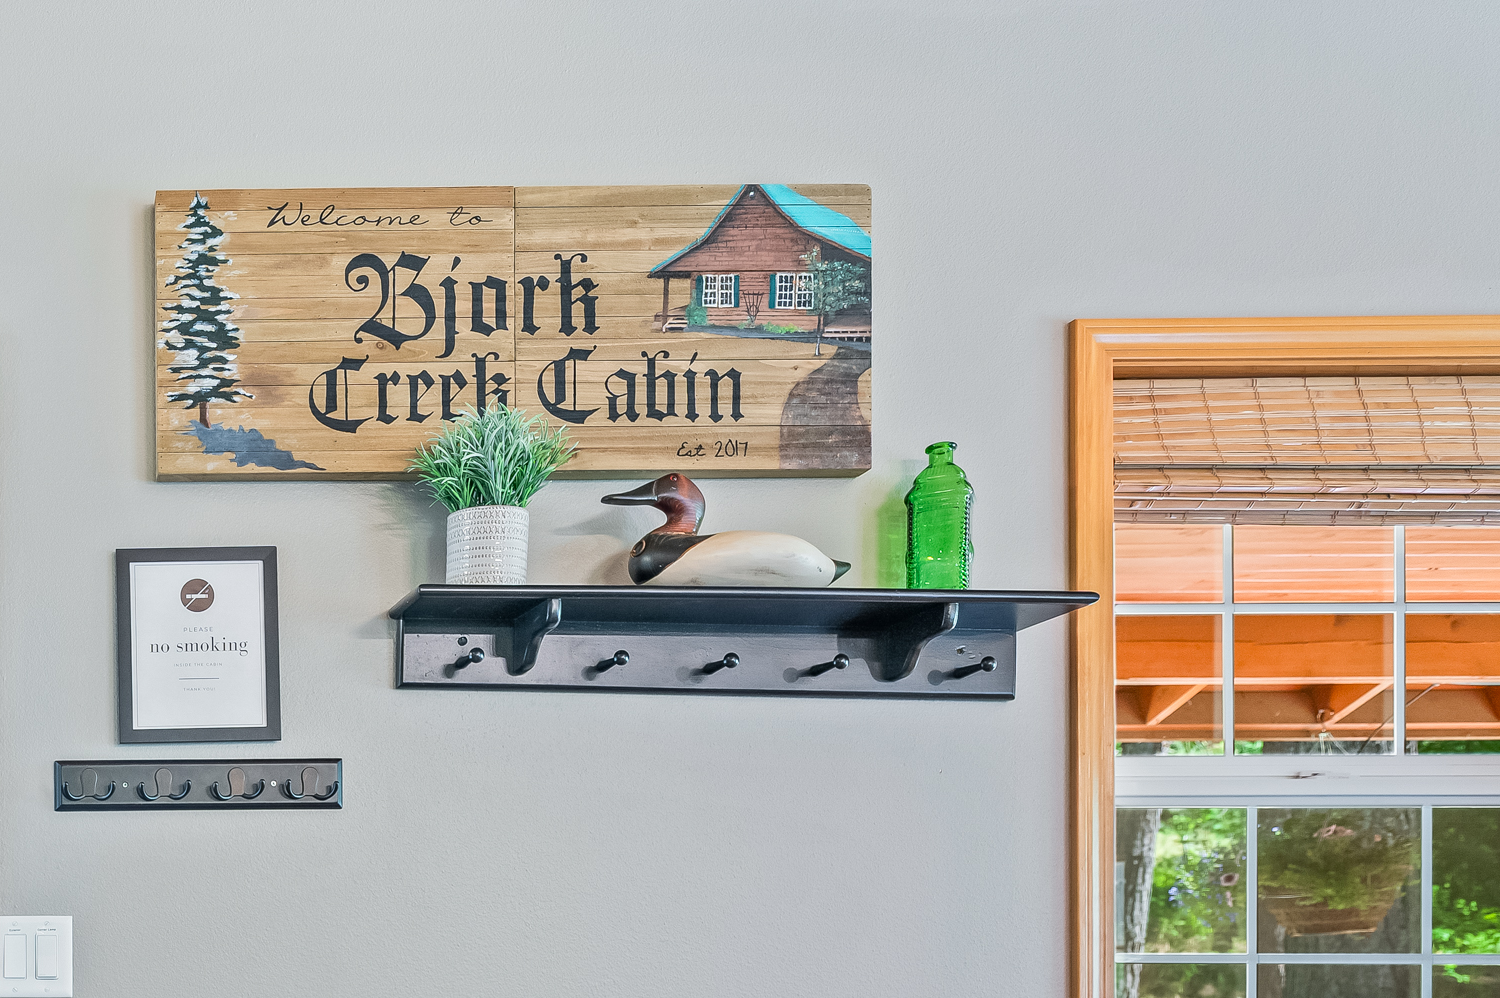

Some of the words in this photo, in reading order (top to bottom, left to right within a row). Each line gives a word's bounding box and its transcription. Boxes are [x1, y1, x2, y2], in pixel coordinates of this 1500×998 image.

[266, 201, 430, 229] Welcome
[446, 206, 494, 227] to
[344, 251, 601, 359] Bjork
[308, 351, 513, 434] Creek
[536, 344, 746, 428] Cabin
[676, 441, 707, 458] Est
[714, 438, 749, 458] 2017
[150, 641, 170, 654] no
[176, 635, 249, 657] smoking
